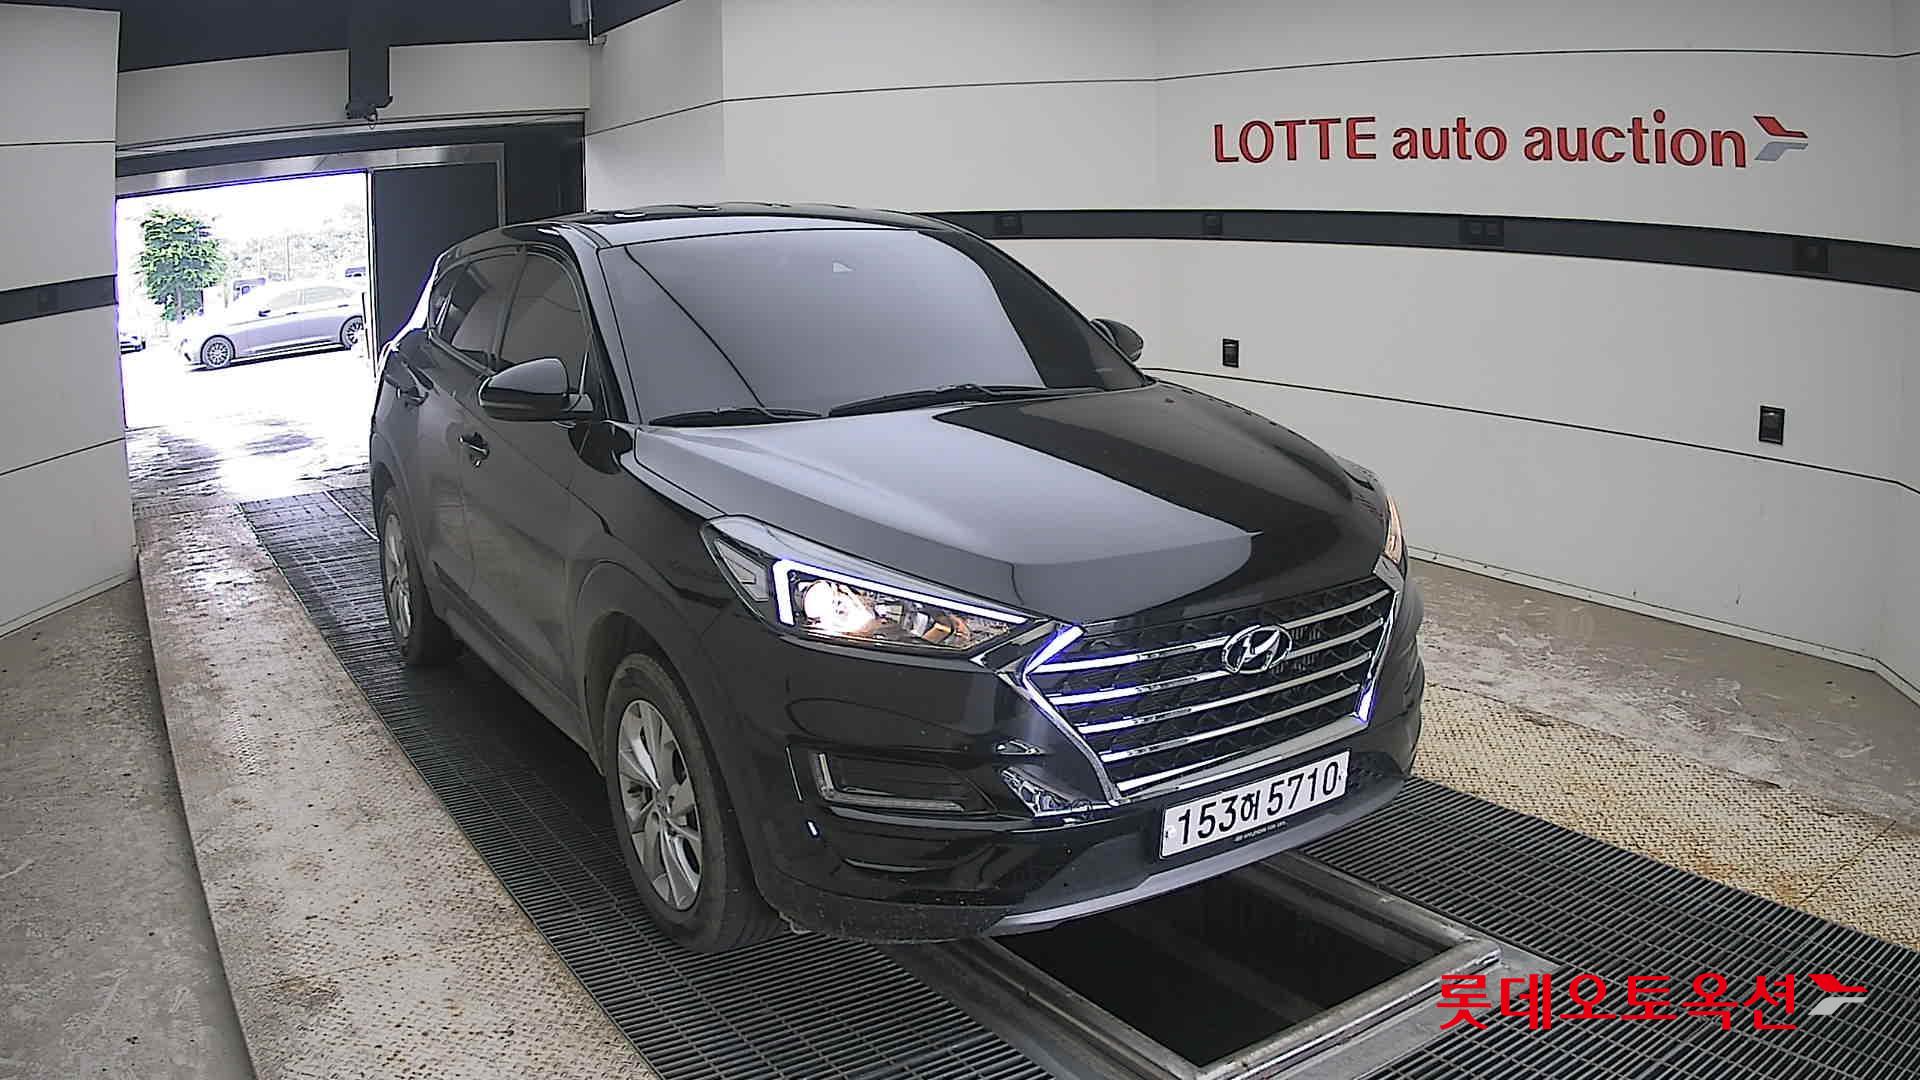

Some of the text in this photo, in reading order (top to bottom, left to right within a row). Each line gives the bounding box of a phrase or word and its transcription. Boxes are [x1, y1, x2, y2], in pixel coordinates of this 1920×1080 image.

[1214, 109, 1748, 169] LOTTE auto auction
[1267, 761, 1339, 816] 5710
